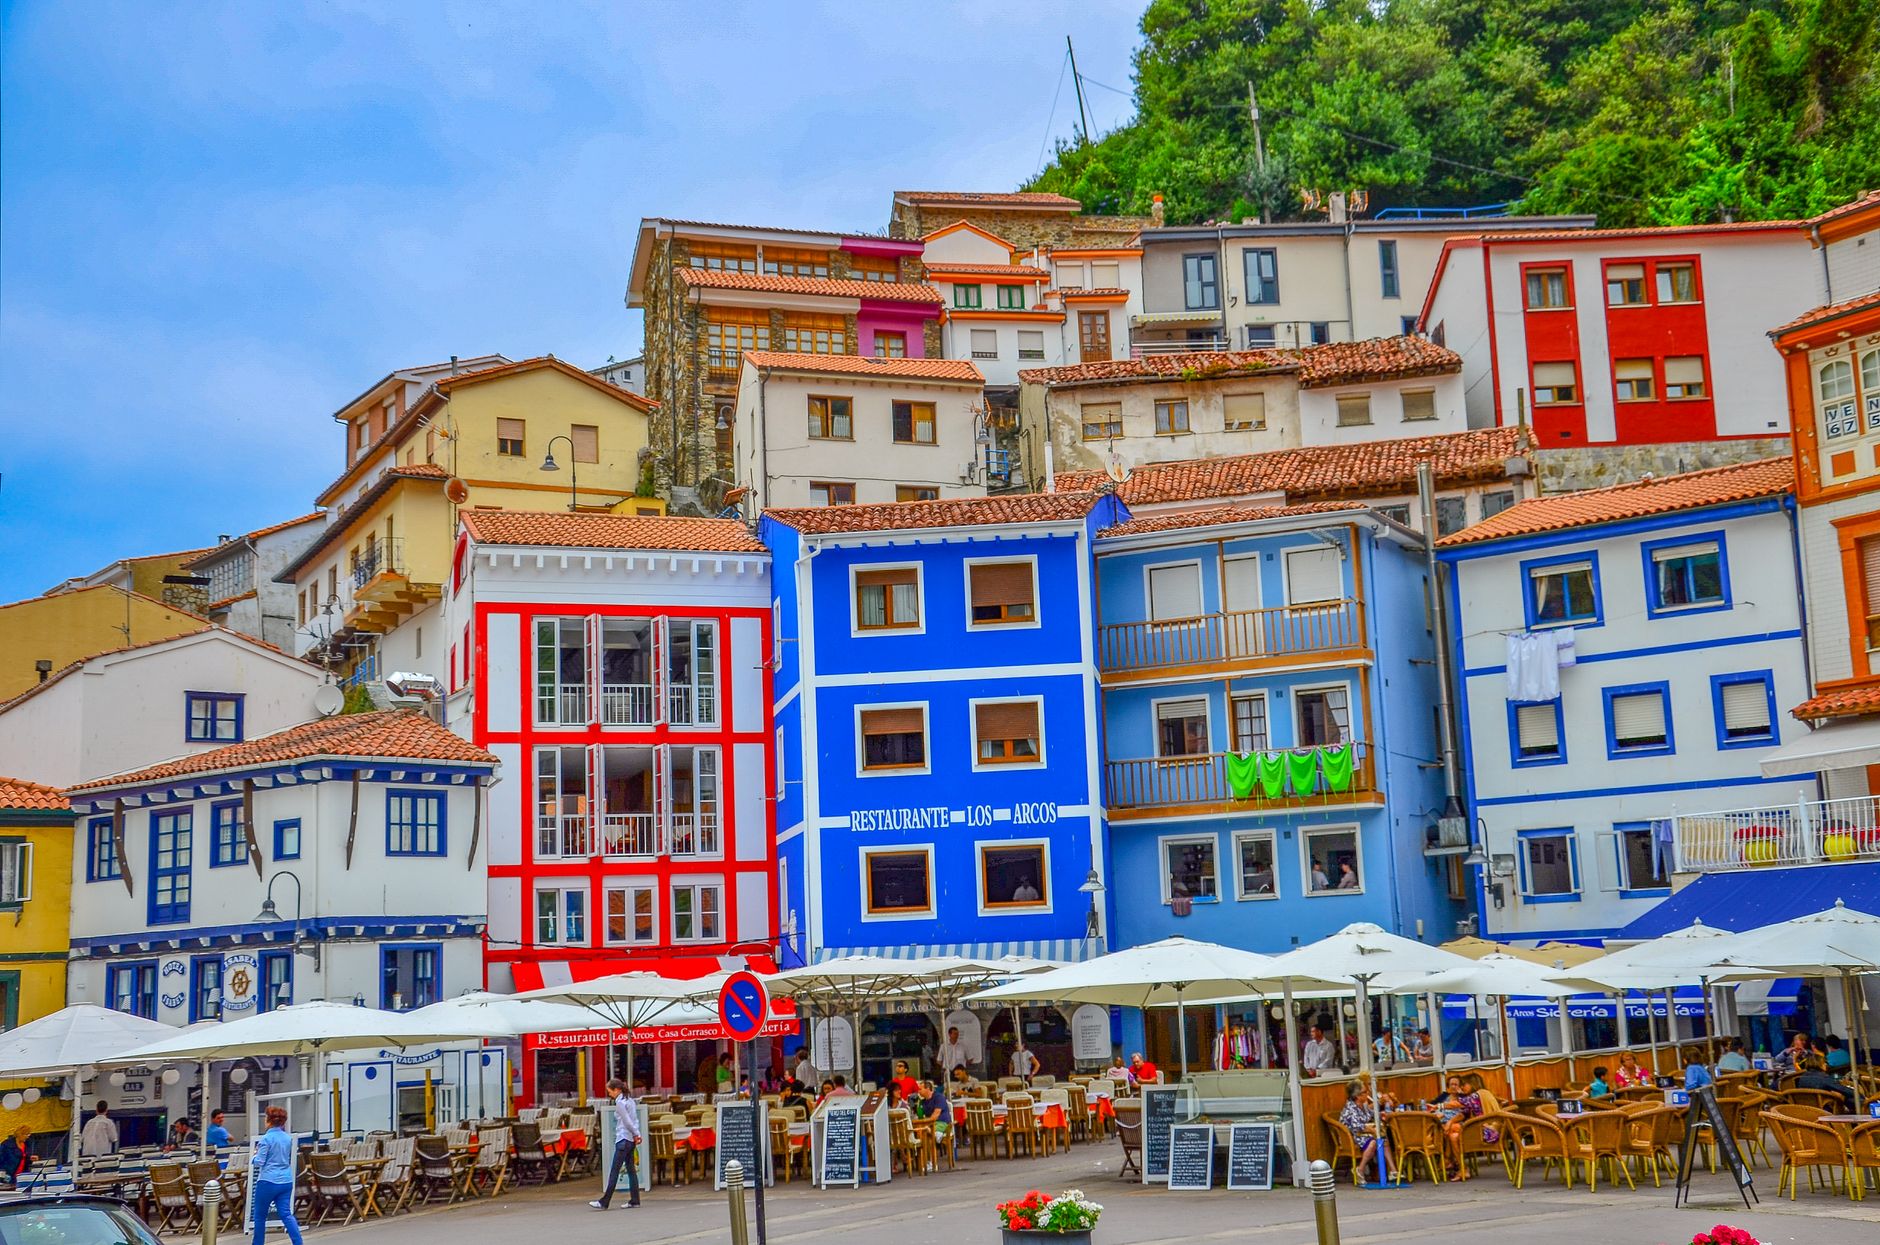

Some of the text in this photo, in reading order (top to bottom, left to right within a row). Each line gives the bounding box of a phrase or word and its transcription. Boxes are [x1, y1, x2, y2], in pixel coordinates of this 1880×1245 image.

[851, 802, 1057, 832] RESTAURANTE LOS ARCOS
[163, 961, 184, 975] HOTEL
[224, 954, 256, 968] ISABEL
[891, 1003, 907, 1013] Los
[911, 1000, 936, 1012] Arcos
[945, 1002, 964, 1010] asa
[1513, 1008, 1535, 1017] Arcos
[1536, 1005, 1608, 1018] Sidería
[1625, 1004, 1690, 1017] Taeía
[612, 1031, 628, 1041] Los
[631, 1029, 655, 1041] Arcos
[658, 1028, 679, 1038] Casa
[680, 1026, 718, 1037] Carrasco
[383, 1051, 438, 1064] RETAURANTE
